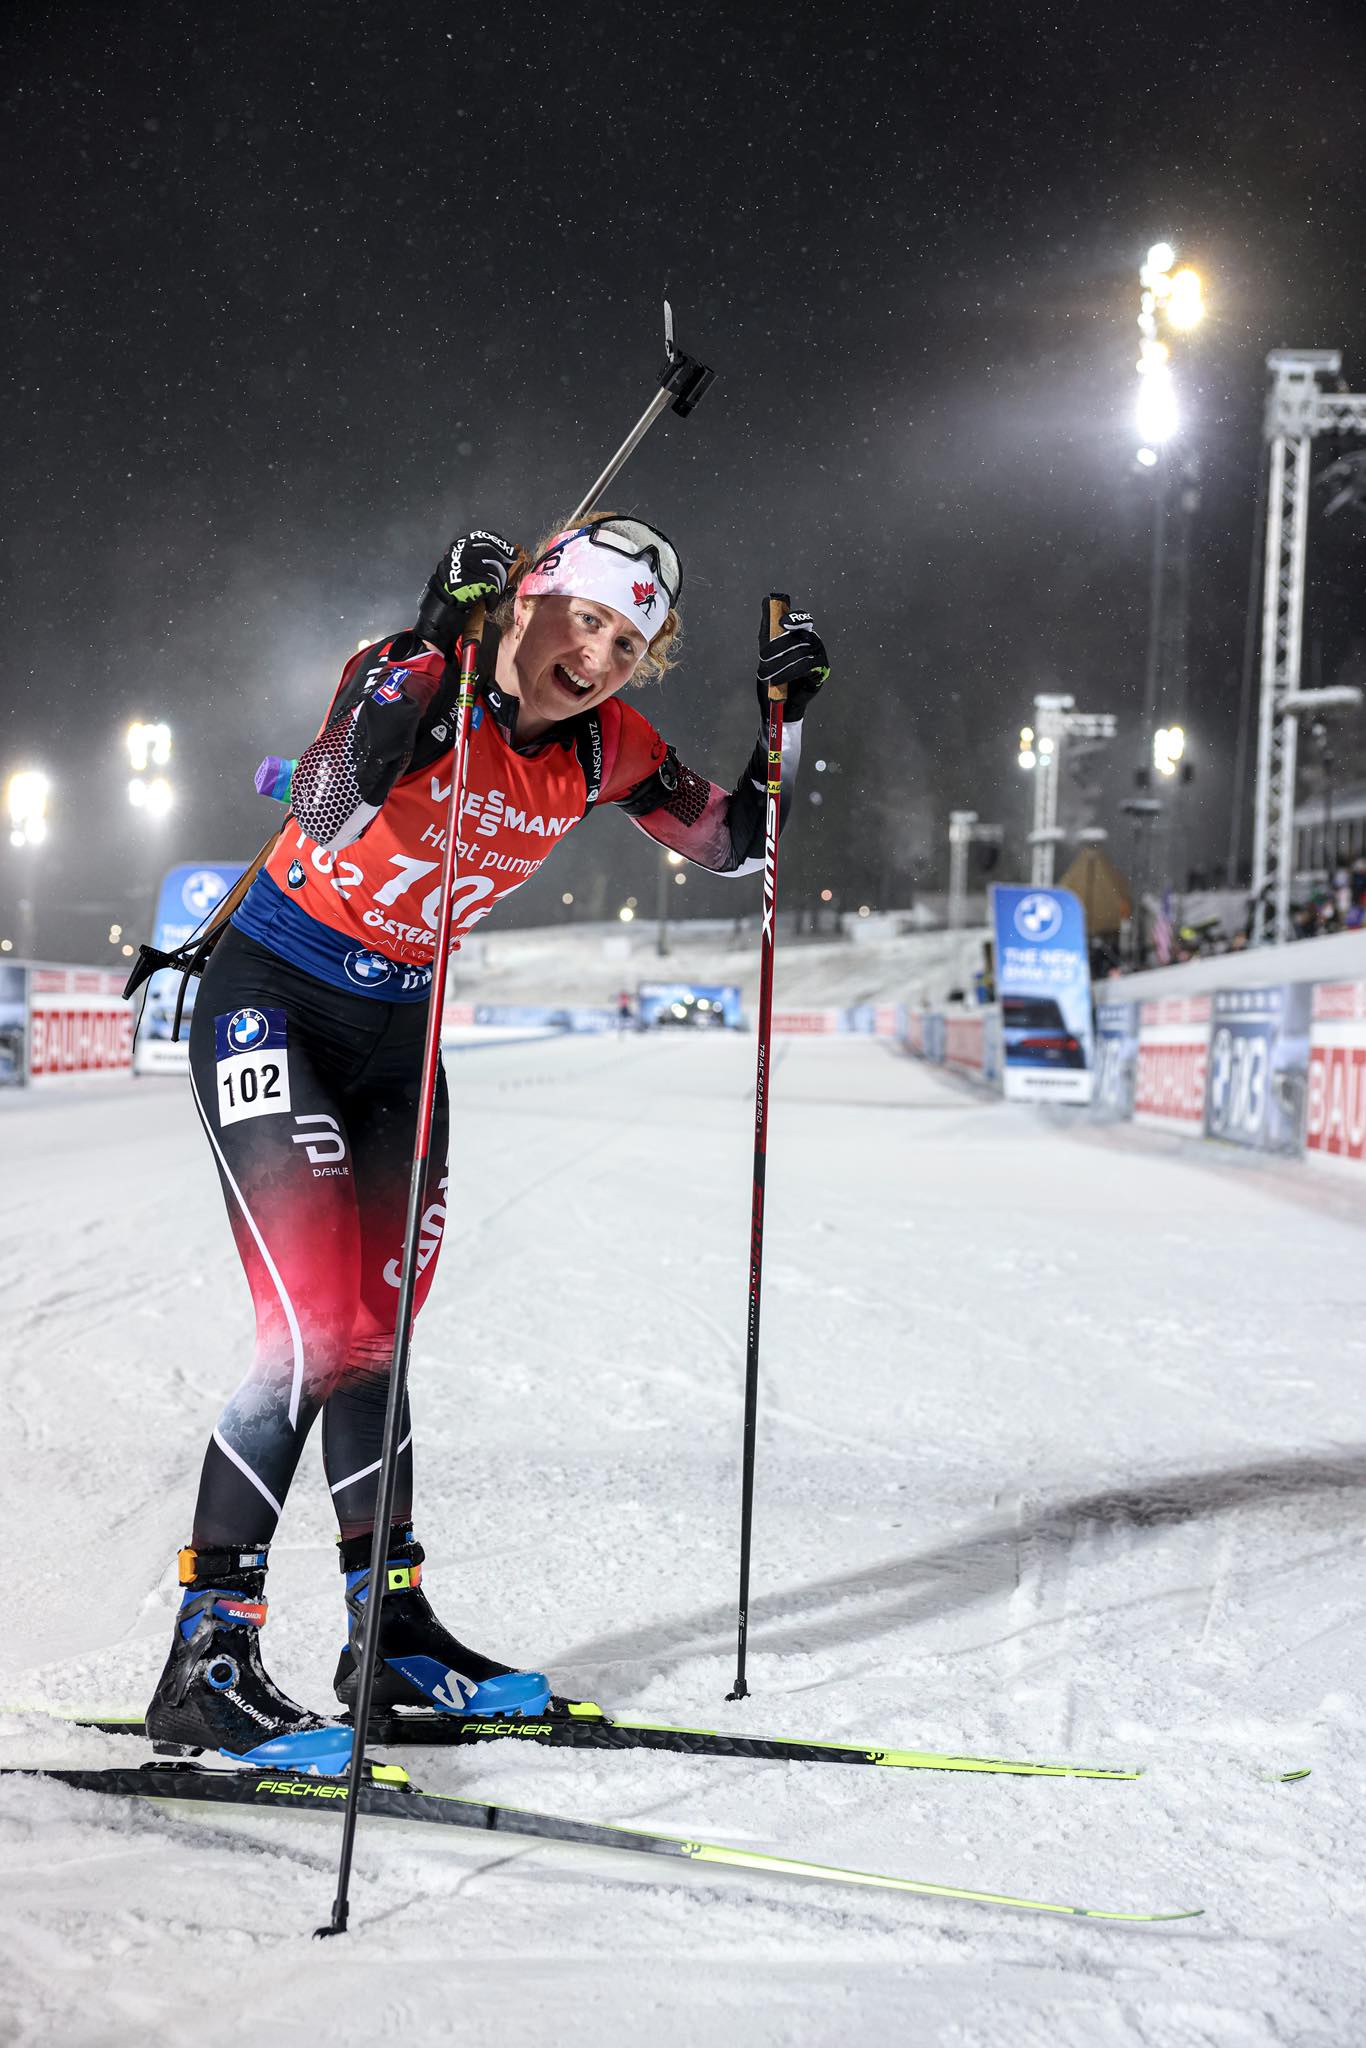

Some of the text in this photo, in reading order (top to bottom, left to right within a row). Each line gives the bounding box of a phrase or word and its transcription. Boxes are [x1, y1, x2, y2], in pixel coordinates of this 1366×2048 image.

[589, 721, 602, 780] ANSCHÜTZ
[431, 776, 582, 837] VESSMAN
[762, 797, 776, 947] SWIX
[231, 1010, 263, 1026] BMW
[758, 1043, 766, 1076] TRIAC
[223, 1064, 281, 1107] 102
[224, 1690, 278, 1729] SALOMON
[461, 1723, 553, 1735] FISCHER
[255, 1781, 349, 1800] FISCHER
